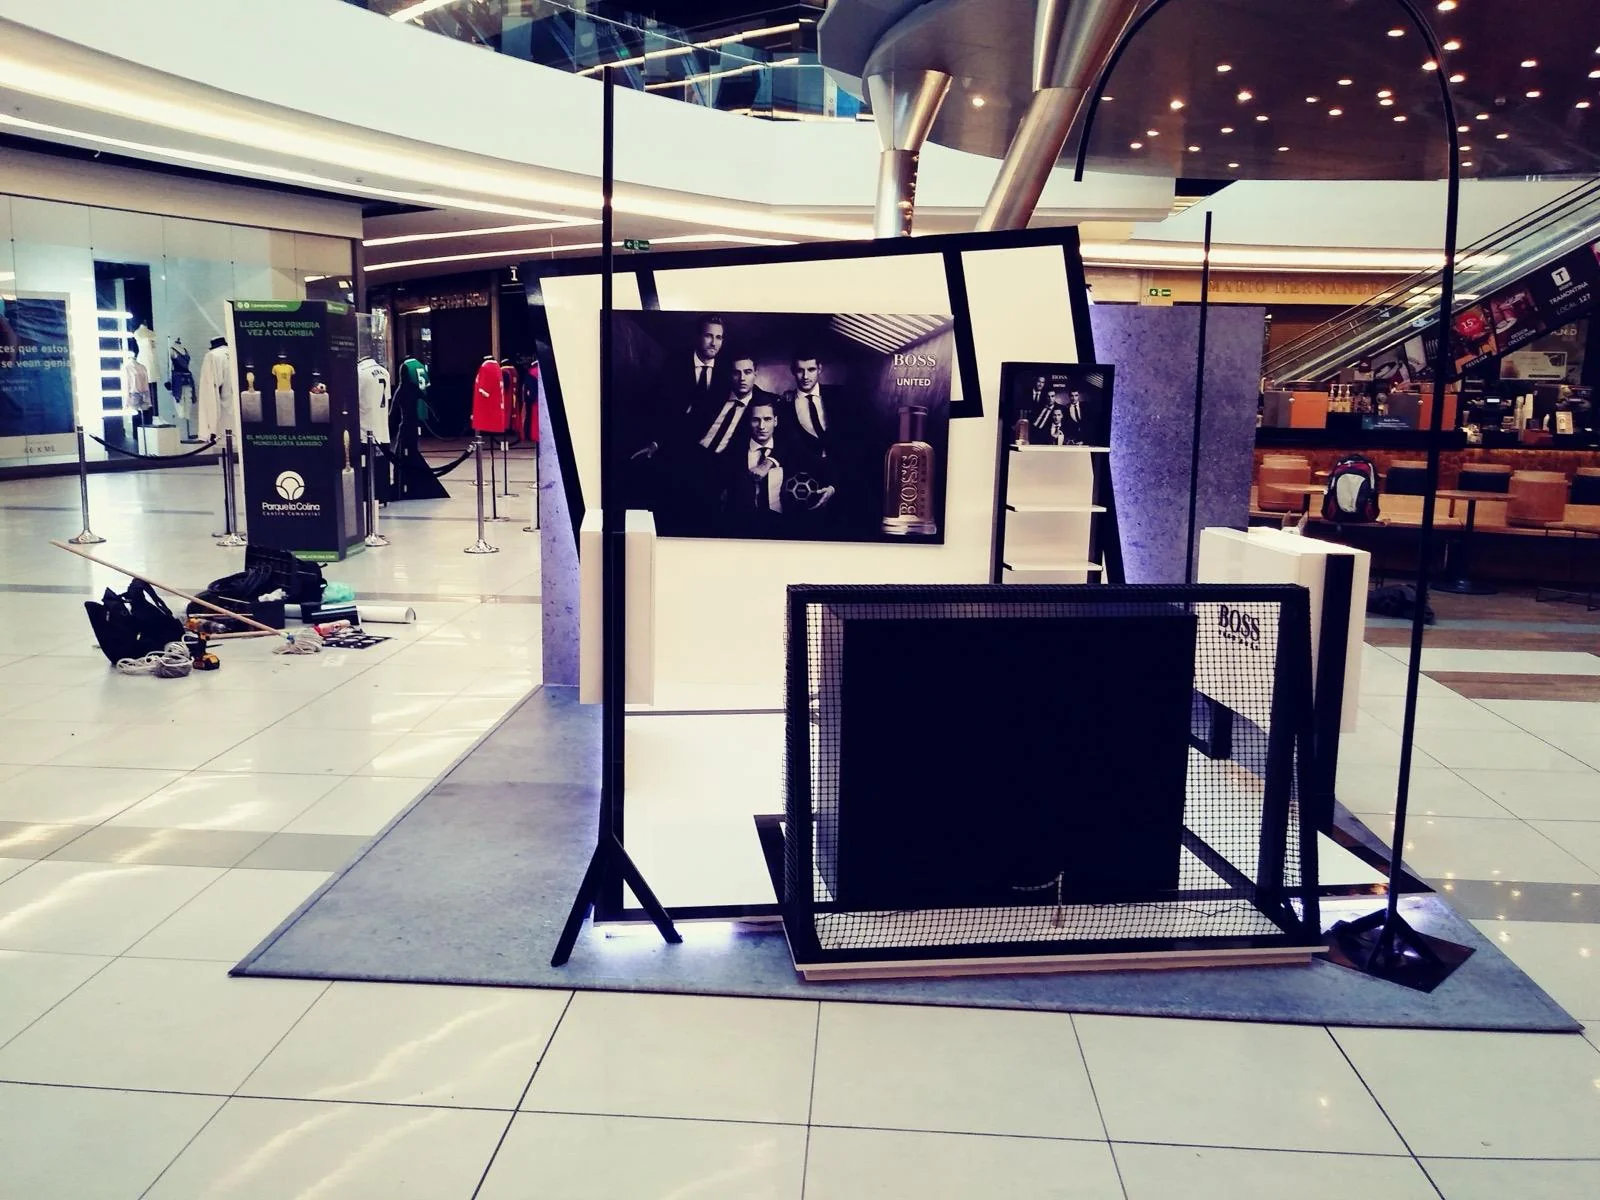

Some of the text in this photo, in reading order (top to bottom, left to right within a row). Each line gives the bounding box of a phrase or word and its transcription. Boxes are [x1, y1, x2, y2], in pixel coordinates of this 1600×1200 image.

[1275, 281, 1390, 295] HERNANDE
[1549, 281, 1588, 304] TRAMONTINA
[240, 320, 320, 329] LLEGA POR PRIMERA
[247, 329, 314, 338] VEZ A COLOMBIA
[18, 345, 38, 355] que
[41, 344, 69, 353] estos
[1, 360, 13, 368] se
[893, 354, 937, 367] BOSS
[897, 378, 931, 387] UNITED
[378, 378, 386, 408] 7
[900, 453, 919, 516] BOSS
[1219, 604, 1260, 641] BOSS
